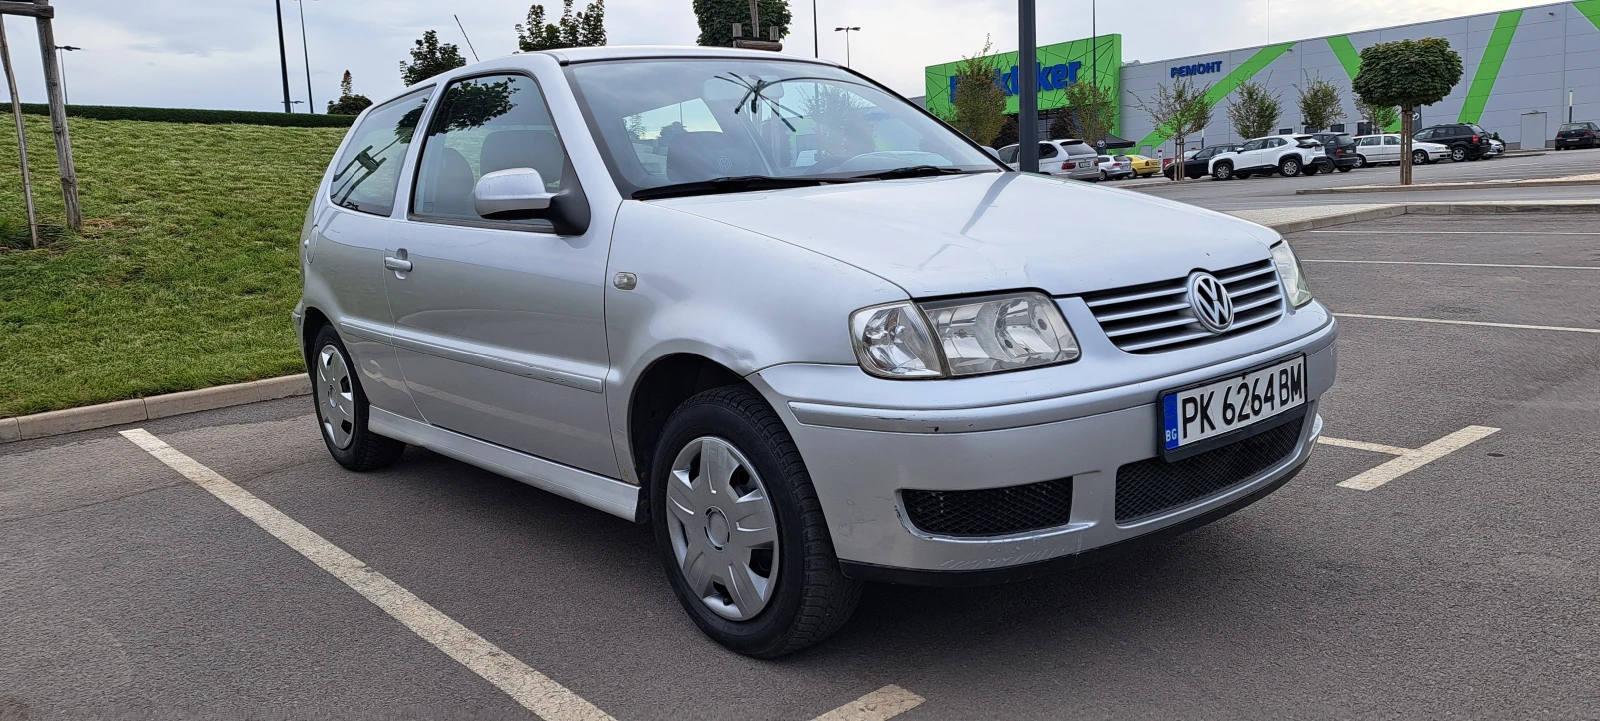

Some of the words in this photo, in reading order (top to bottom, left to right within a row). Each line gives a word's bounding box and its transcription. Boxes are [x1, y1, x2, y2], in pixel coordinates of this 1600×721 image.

[950, 61, 1081, 104] ktker
[1170, 61, 1222, 78] РЕМОНТ
[1182, 390, 1216, 439] PK
[1222, 373, 1275, 426] 6264
[1279, 362, 1303, 407] BM
[1165, 428, 1178, 442] BG
